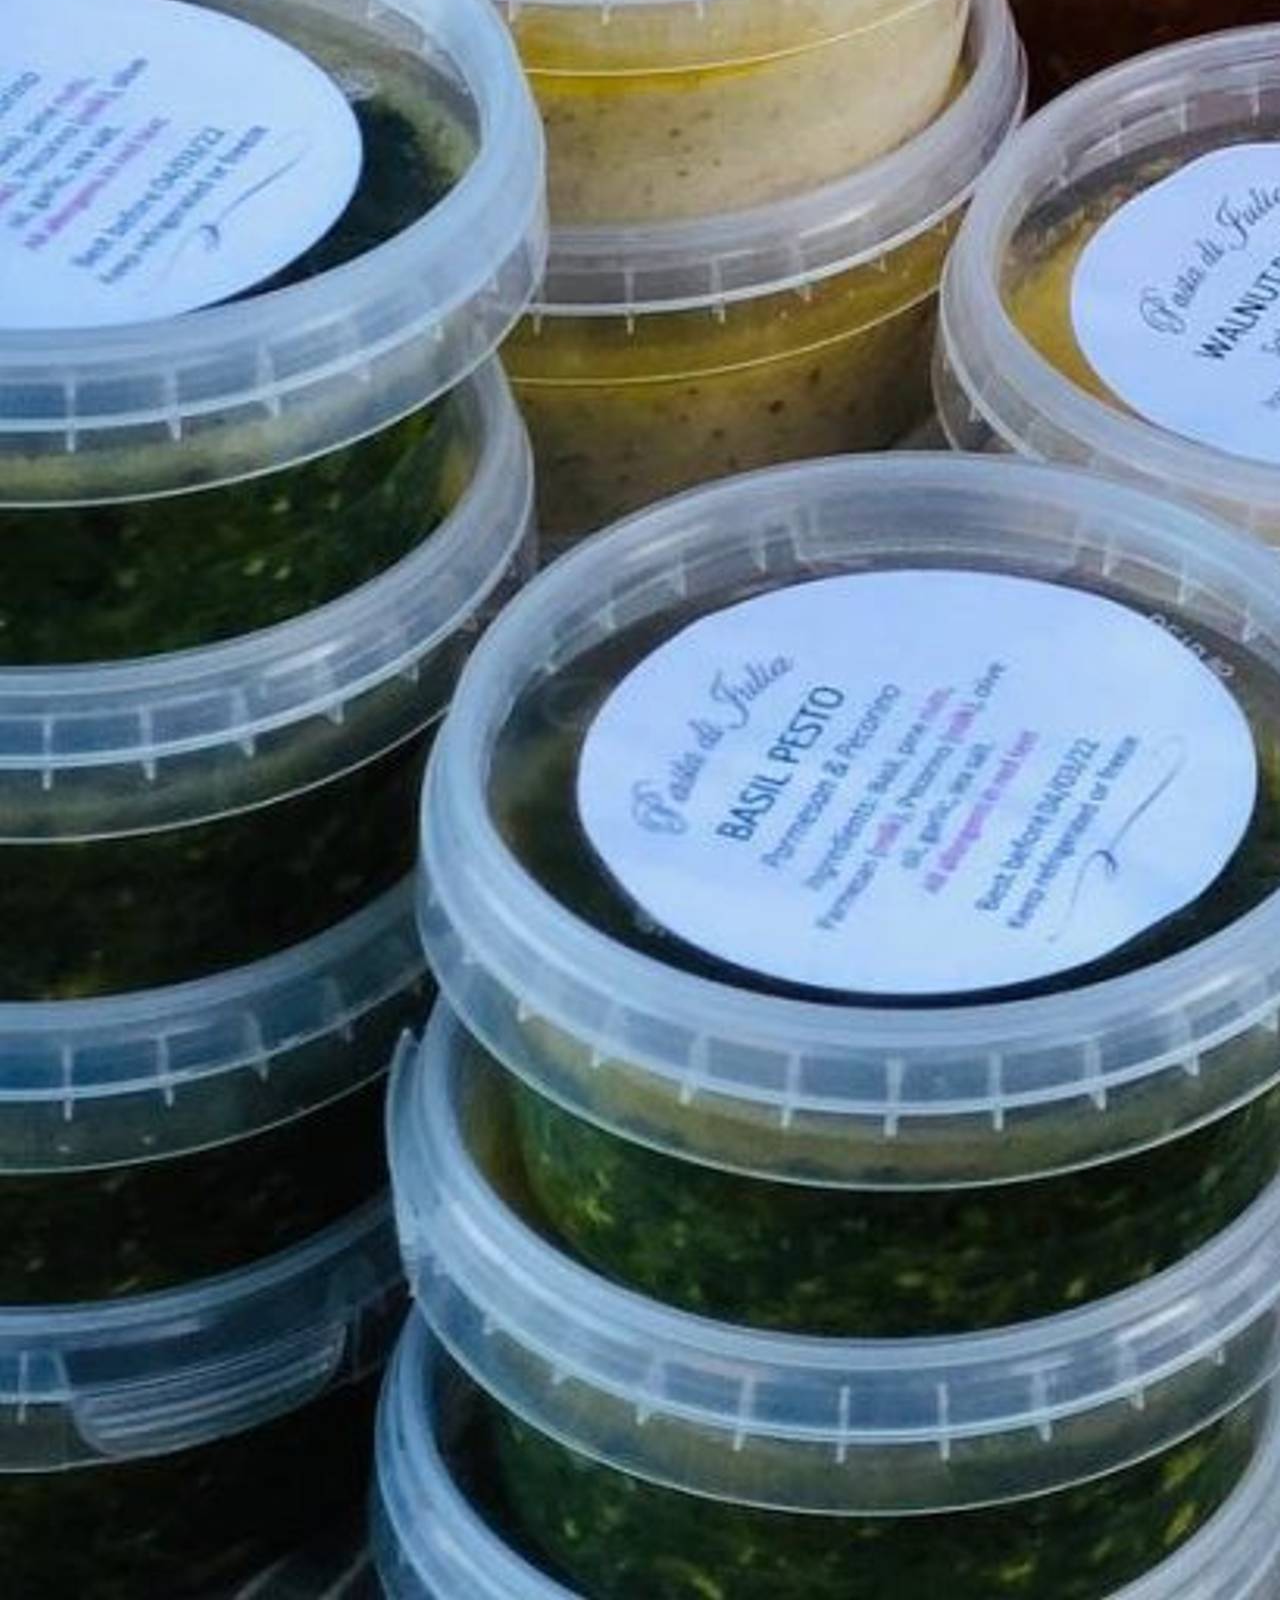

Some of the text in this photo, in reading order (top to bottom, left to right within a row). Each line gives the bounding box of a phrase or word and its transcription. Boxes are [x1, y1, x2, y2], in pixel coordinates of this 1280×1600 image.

[714, 685, 846, 843] BASIL PESTO
[760, 683, 902, 869] Parmesan & Pecorino
[974, 872, 1017, 913] Best
[999, 814, 1053, 871] before
